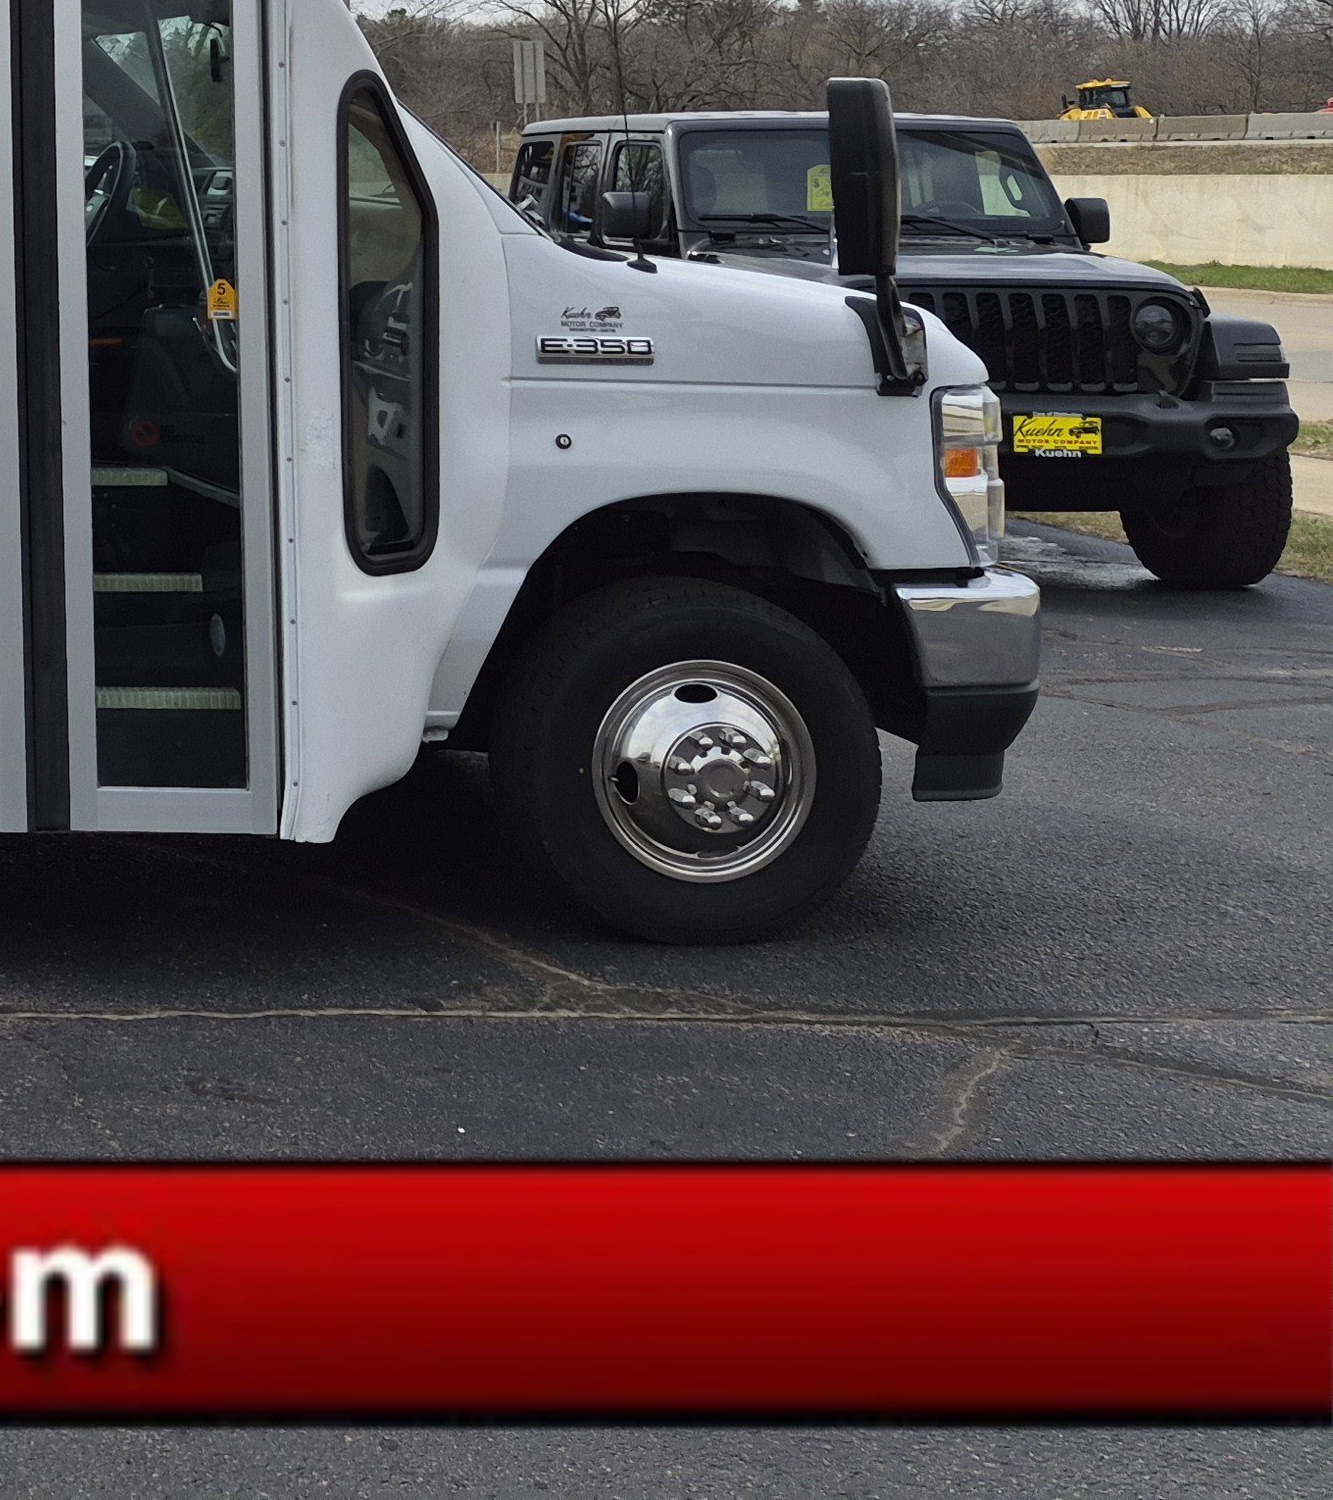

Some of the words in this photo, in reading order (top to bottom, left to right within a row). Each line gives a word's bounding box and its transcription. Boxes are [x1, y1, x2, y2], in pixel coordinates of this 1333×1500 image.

[216, 282, 226, 295] 5
[589, 321, 624, 329] COMPANY
[1013, 418, 1064, 438] Kuehn
[1034, 448, 1082, 458] Kuehn
